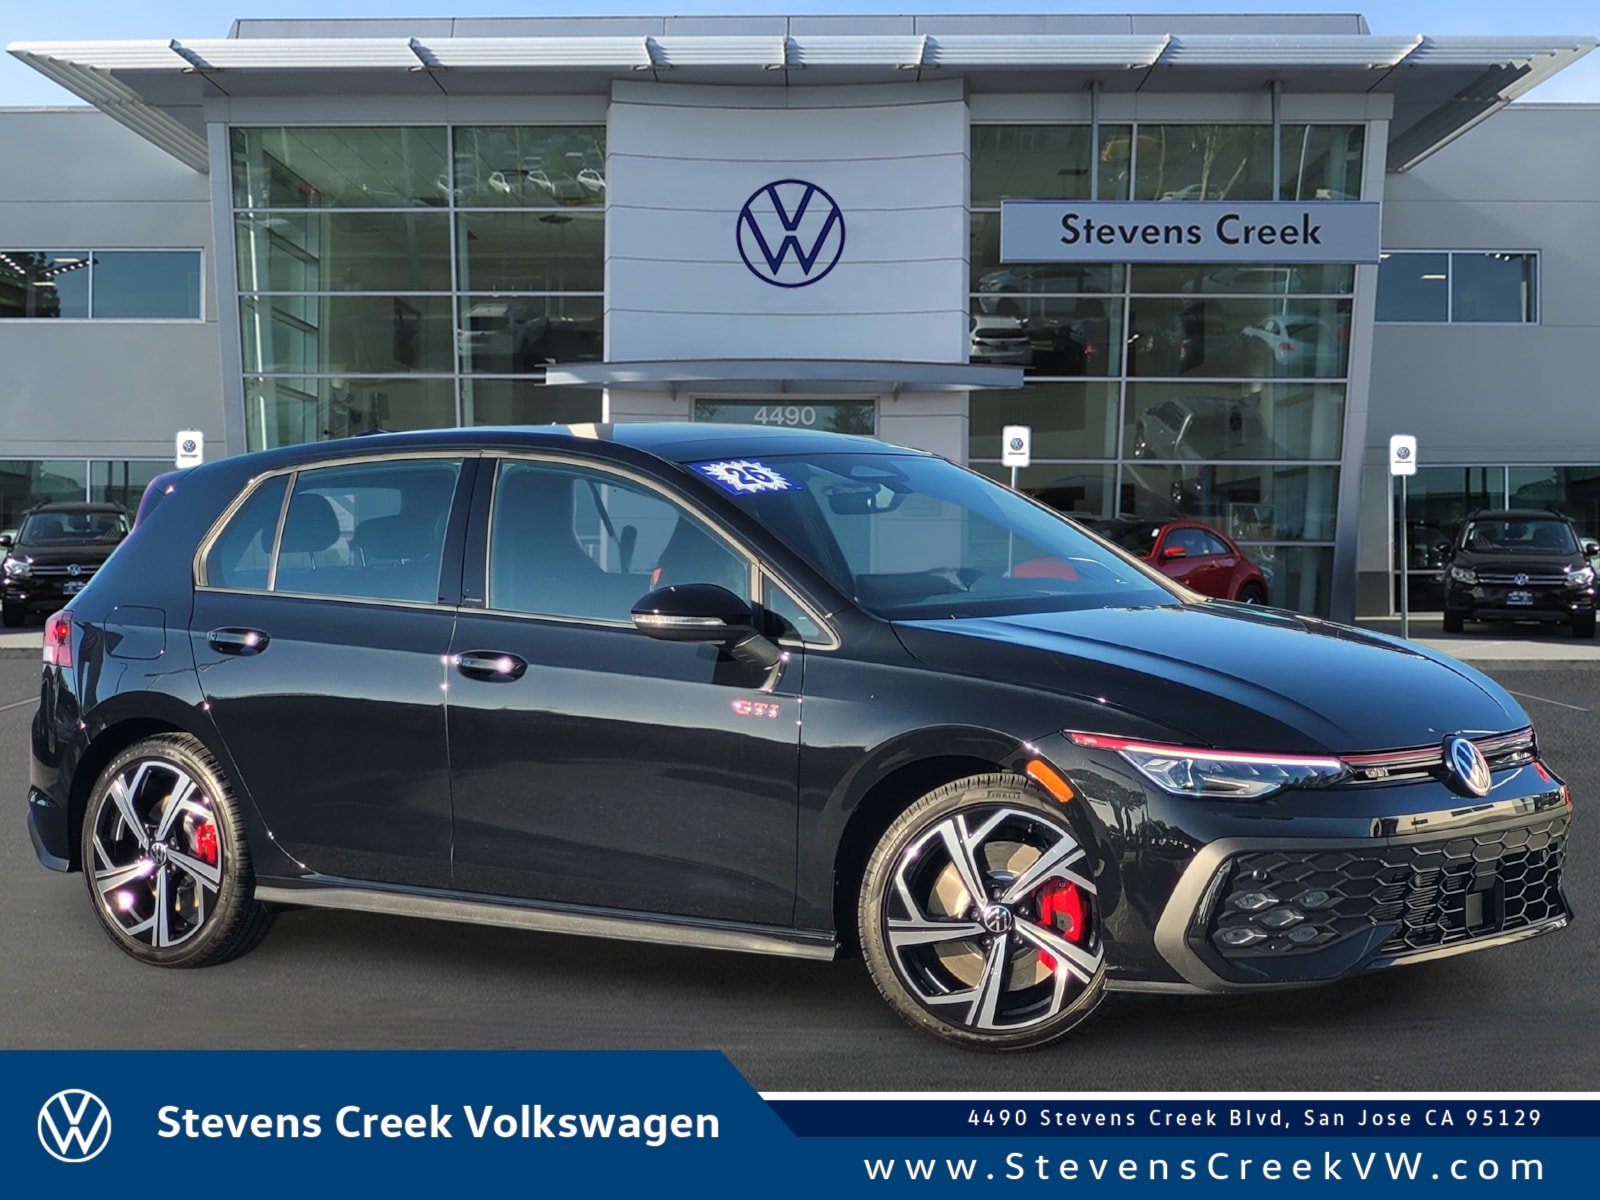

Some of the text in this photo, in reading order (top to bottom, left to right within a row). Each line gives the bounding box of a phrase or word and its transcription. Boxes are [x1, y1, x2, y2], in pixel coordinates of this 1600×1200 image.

[736, 178, 846, 288] VW
[1060, 212, 1322, 245] Stevens Creek
[754, 406, 816, 425] 4490
[724, 466, 775, 484] 26
[732, 700, 780, 718] GTI
